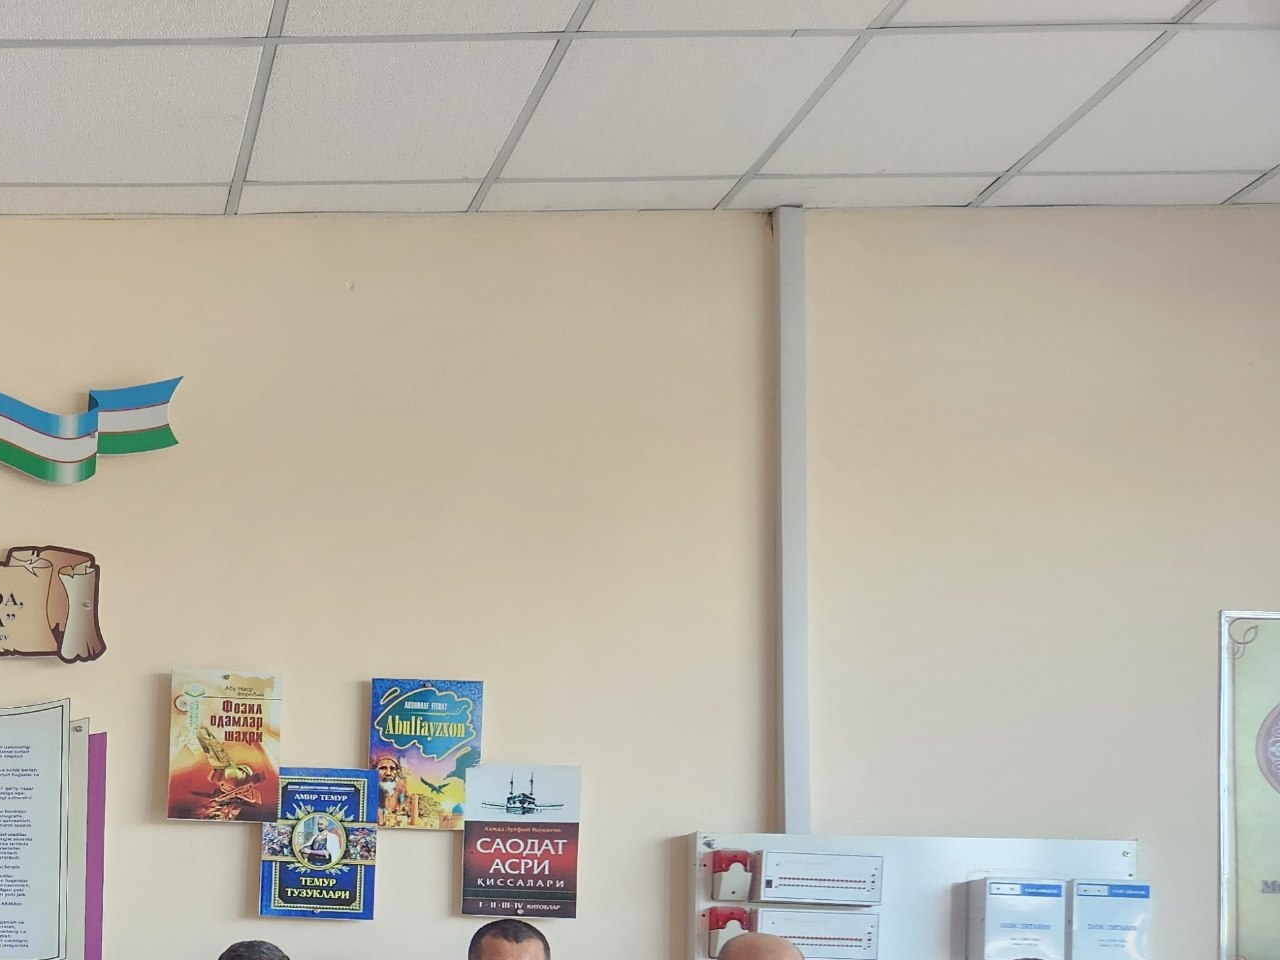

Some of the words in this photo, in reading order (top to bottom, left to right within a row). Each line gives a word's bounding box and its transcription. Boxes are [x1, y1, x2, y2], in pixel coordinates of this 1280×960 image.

[223, 700, 262, 714] Фозил
[210, 715, 262, 730] одамлар
[385, 715, 465, 741] Abulfayzxon
[476, 838, 567, 857] САОДАТ
[489, 859, 549, 874] АСРИ
[300, 877, 336, 886] ТЕМУР
[286, 888, 350, 899] ТУЗУКЛАРИ
